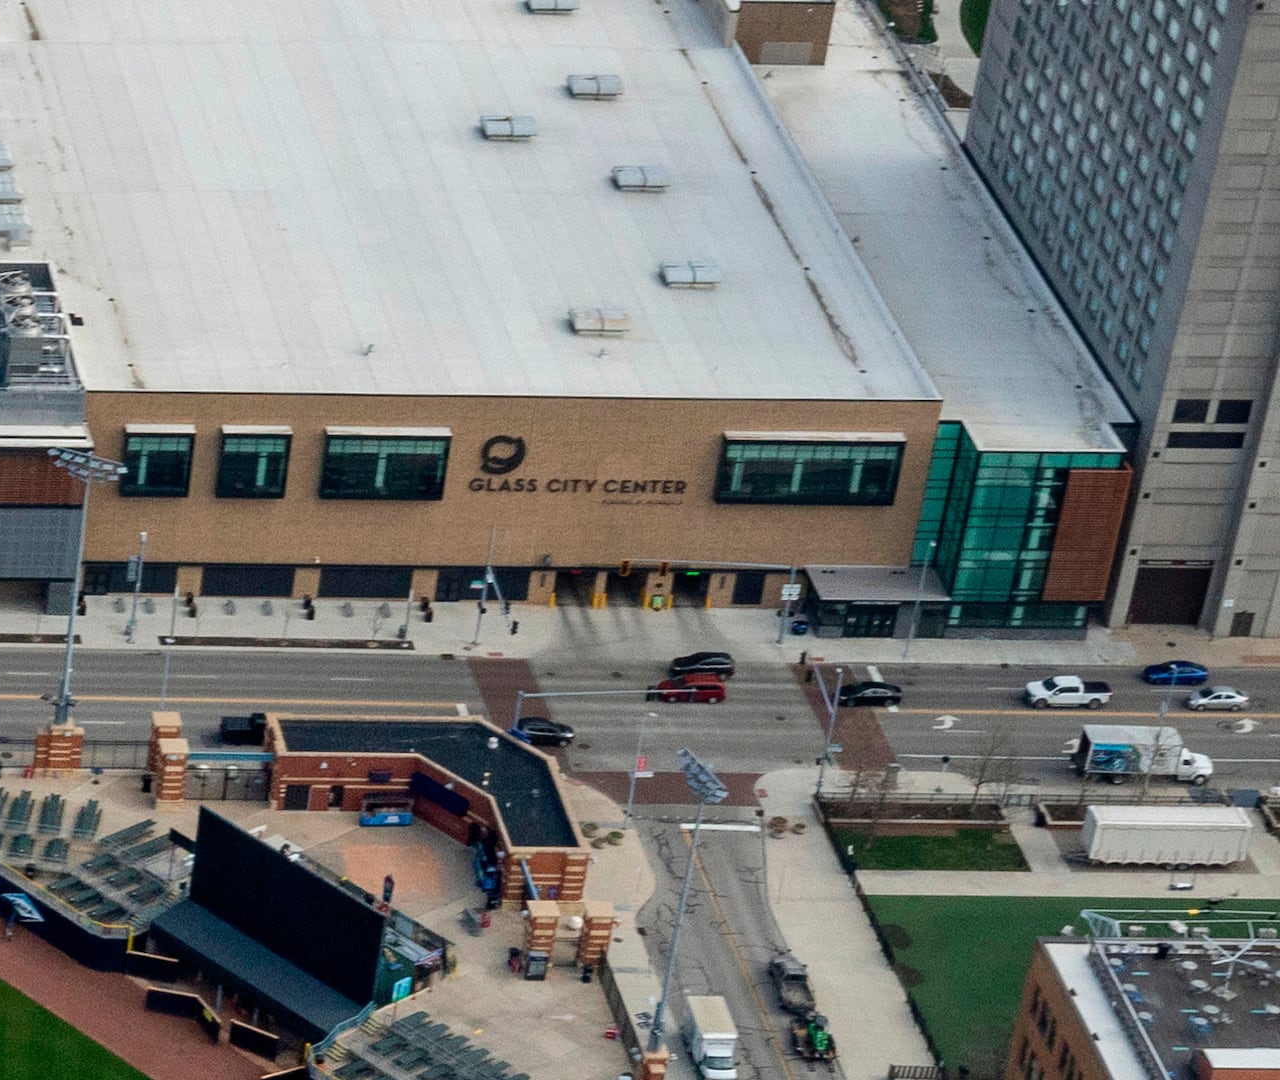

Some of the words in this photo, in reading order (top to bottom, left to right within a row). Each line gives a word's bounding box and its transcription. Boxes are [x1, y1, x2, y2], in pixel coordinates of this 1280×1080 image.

[469, 478, 538, 493] GLASS
[545, 478, 597, 493] CITY
[603, 480, 688, 494] CENTER
